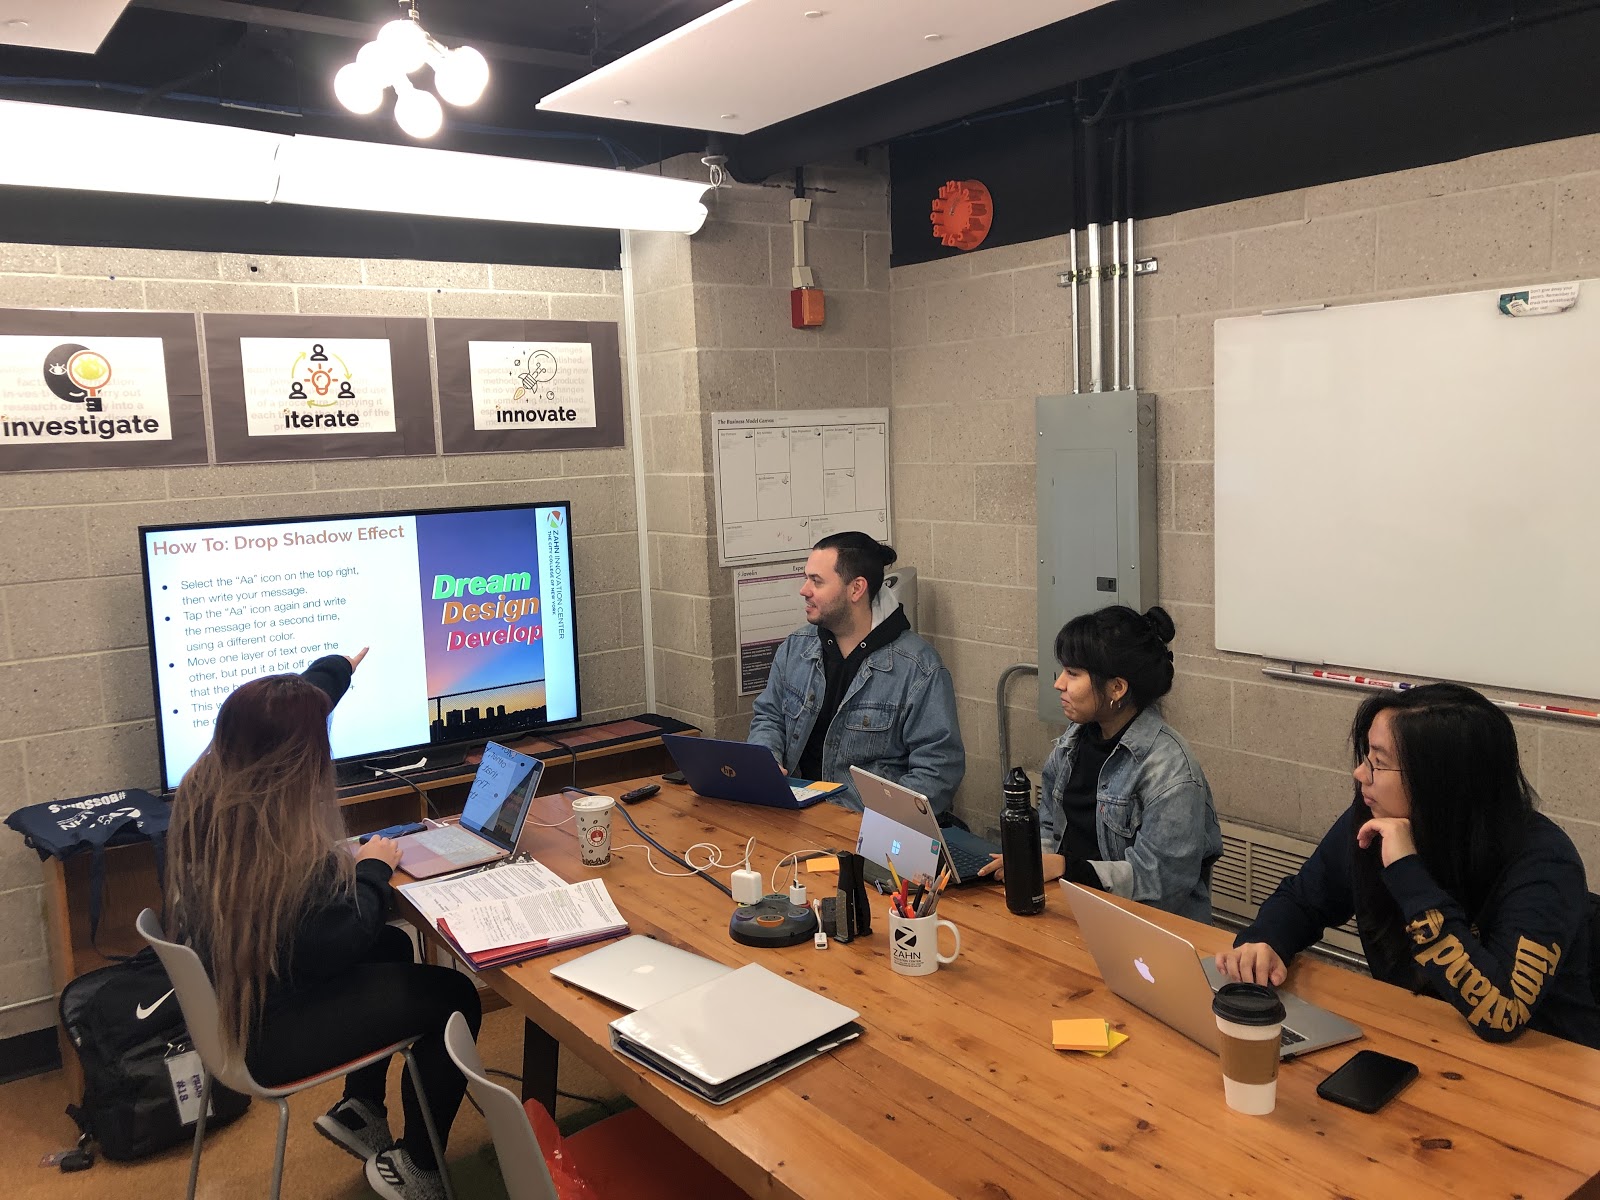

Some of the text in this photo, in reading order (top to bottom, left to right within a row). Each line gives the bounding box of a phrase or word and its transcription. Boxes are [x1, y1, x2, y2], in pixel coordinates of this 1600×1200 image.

[284, 408, 359, 428] iterate
[496, 405, 577, 423] innovate
[2, 415, 159, 440] investigate
[153, 525, 405, 555] How To: Drop Shadow Effect
[181, 579, 213, 590] Select
[217, 578, 233, 587] the
[260, 573, 282, 582] icon
[300, 571, 314, 579] the
[317, 569, 333, 578] top
[336, 566, 359, 578] right,
[432, 571, 531, 600] Dream
[555, 555, 563, 607] INNOVATION
[182, 586, 308, 605] then write your message.
[183, 611, 202, 622] Tap
[205, 609, 222, 618] the
[250, 604, 271, 614] icon
[274, 602, 300, 613] again
[303, 600, 321, 609] and
[323, 597, 346, 606] write
[442, 594, 539, 625] Design
[185, 626, 202, 636] the
[205, 622, 251, 635] message
[254, 619, 266, 629] for
[279, 614, 314, 626] second
[317, 612, 340, 623] time,
[186, 641, 214, 652] using
[227, 636, 266, 647] different
[269, 632, 295, 643] color.
[447, 624, 543, 651] Develop
[188, 641, 339, 667] Move one layer of text over the
[189, 672, 218, 682] other,
[221, 669, 238, 678] but
[241, 666, 257, 677] put
[260, 664, 265, 673] it
[278, 662, 290, 670] bit
[292, 660, 305, 669] off
[190, 687, 211, 698] that
[214, 685, 230, 694] the
[191, 702, 213, 712] This
[193, 718, 209, 728] the
[722, 766, 735, 777] hp
[893, 948, 920, 959] ZAHN
